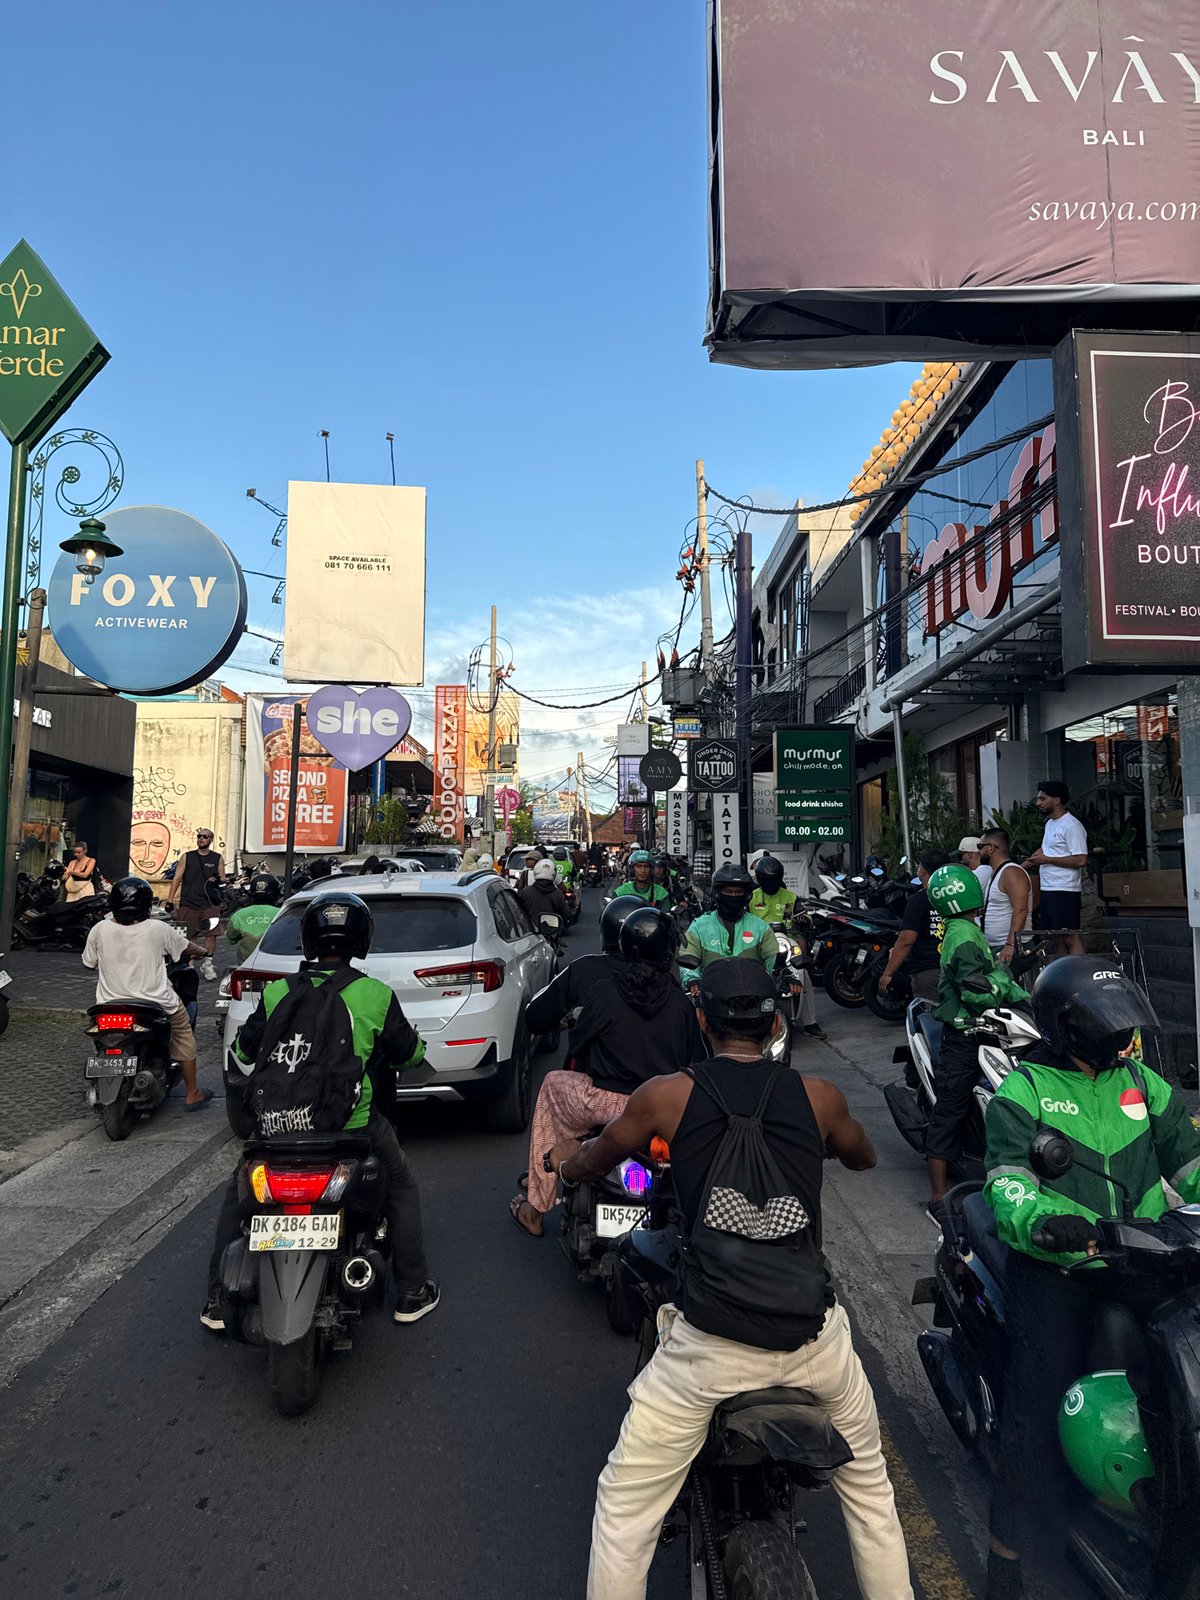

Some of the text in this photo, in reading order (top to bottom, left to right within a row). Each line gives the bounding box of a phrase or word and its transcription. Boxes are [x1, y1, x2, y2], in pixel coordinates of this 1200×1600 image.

[1083, 129, 1145, 146] BALI
[1028, 201, 1200, 230] savaya.com
[0, 326, 66, 345] mar
[0, 348, 64, 377] erde
[344, 562, 354, 570] 70
[357, 563, 373, 571] 666
[69, 573, 218, 608] FOXY
[95, 617, 188, 629] ACTIVEWEAR
[316, 701, 399, 736] she
[442, 700, 459, 769] PIZZA
[697, 748, 734, 759] UNDER SKIN
[783, 749, 842, 761] murmur
[647, 766, 674, 774] AMY
[697, 761, 734, 776] TATTOO
[272, 785, 308, 802] PIZA
[820, 800, 844, 808] shisha
[271, 802, 334, 824] IS REE
[673, 793, 683, 854] MASSAGE
[721, 795, 733, 866] TATTO
[784, 826, 811, 836] 08.00
[818, 826, 844, 836] 02.00
[931, 879, 966, 900] Grab
[441, 989, 463, 997] RS
[1040, 1097, 1079, 1116] Grab
[251, 1216, 338, 1232] DK 6184 GAW
